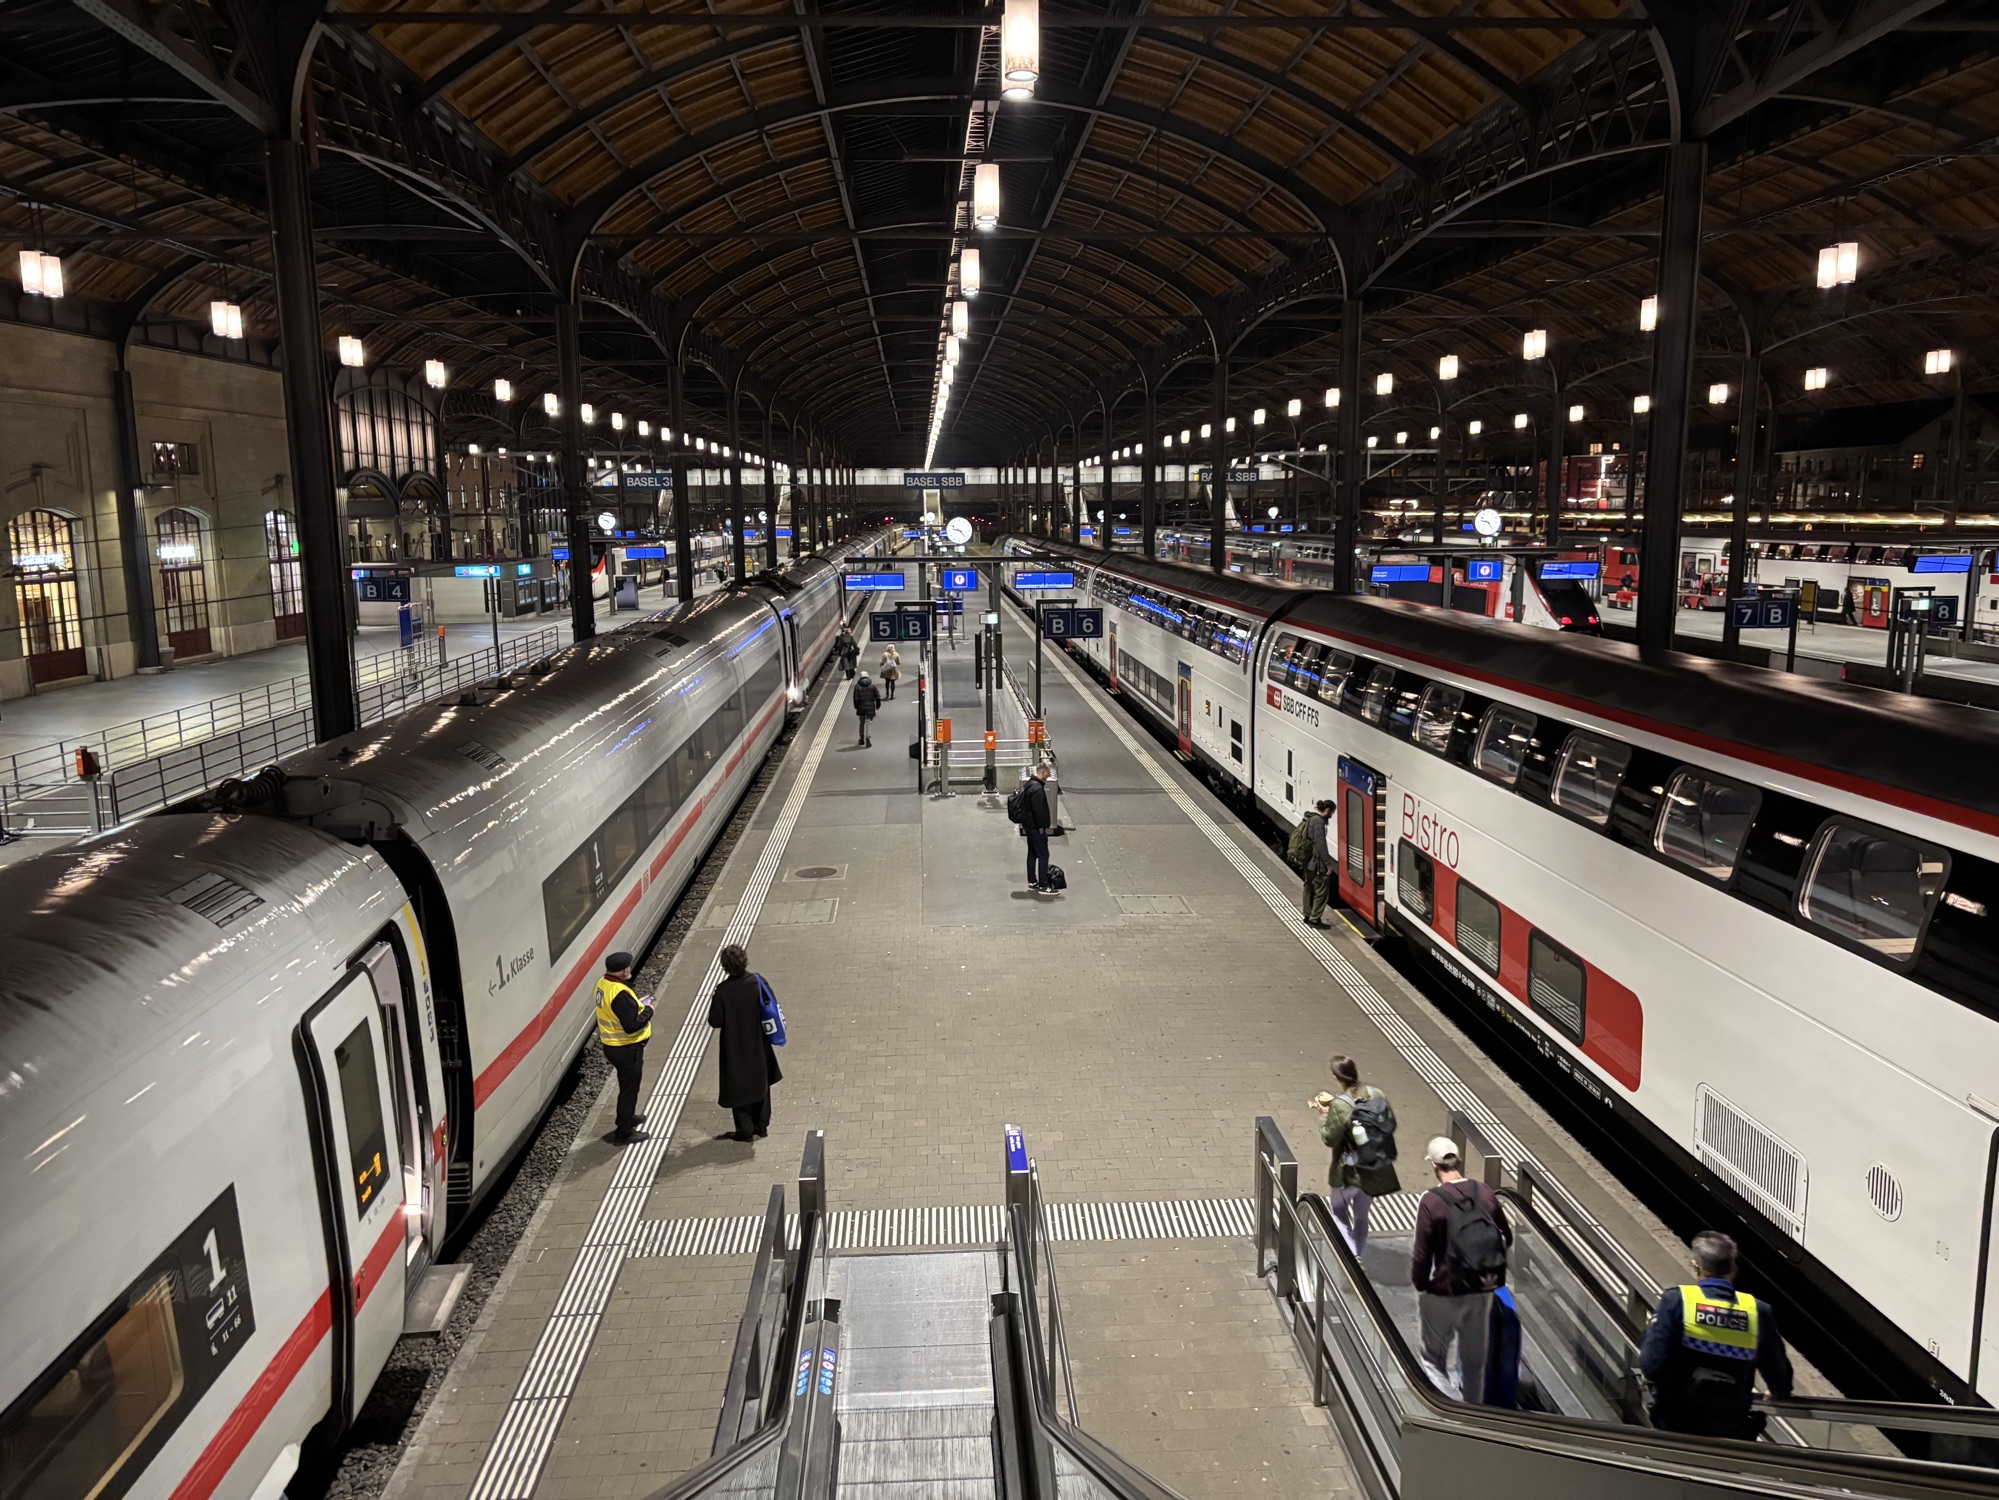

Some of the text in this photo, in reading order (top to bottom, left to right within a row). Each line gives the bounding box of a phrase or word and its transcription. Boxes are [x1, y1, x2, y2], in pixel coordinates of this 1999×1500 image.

[626, 476, 661, 487] BASEL
[906, 476, 963, 487] BASEL SBB
[1235, 471, 1257, 482] SBB
[366, 585, 402, 598] B 4
[1741, 608, 1782, 624] 7 B
[1938, 605, 1949, 619] 8
[879, 620, 921, 636] 5 B
[1052, 617, 1094, 634] B 6
[1283, 694, 1320, 728] SBB CFF FFS
[1367, 776, 1373, 796] 2
[1402, 792, 1460, 869] Bistro
[594, 841, 600, 869] 1
[510, 947, 535, 978] Klasse
[203, 1227, 227, 1292] 1
[227, 1284, 238, 1306] 11
[1696, 1311, 1748, 1332] POLICE
